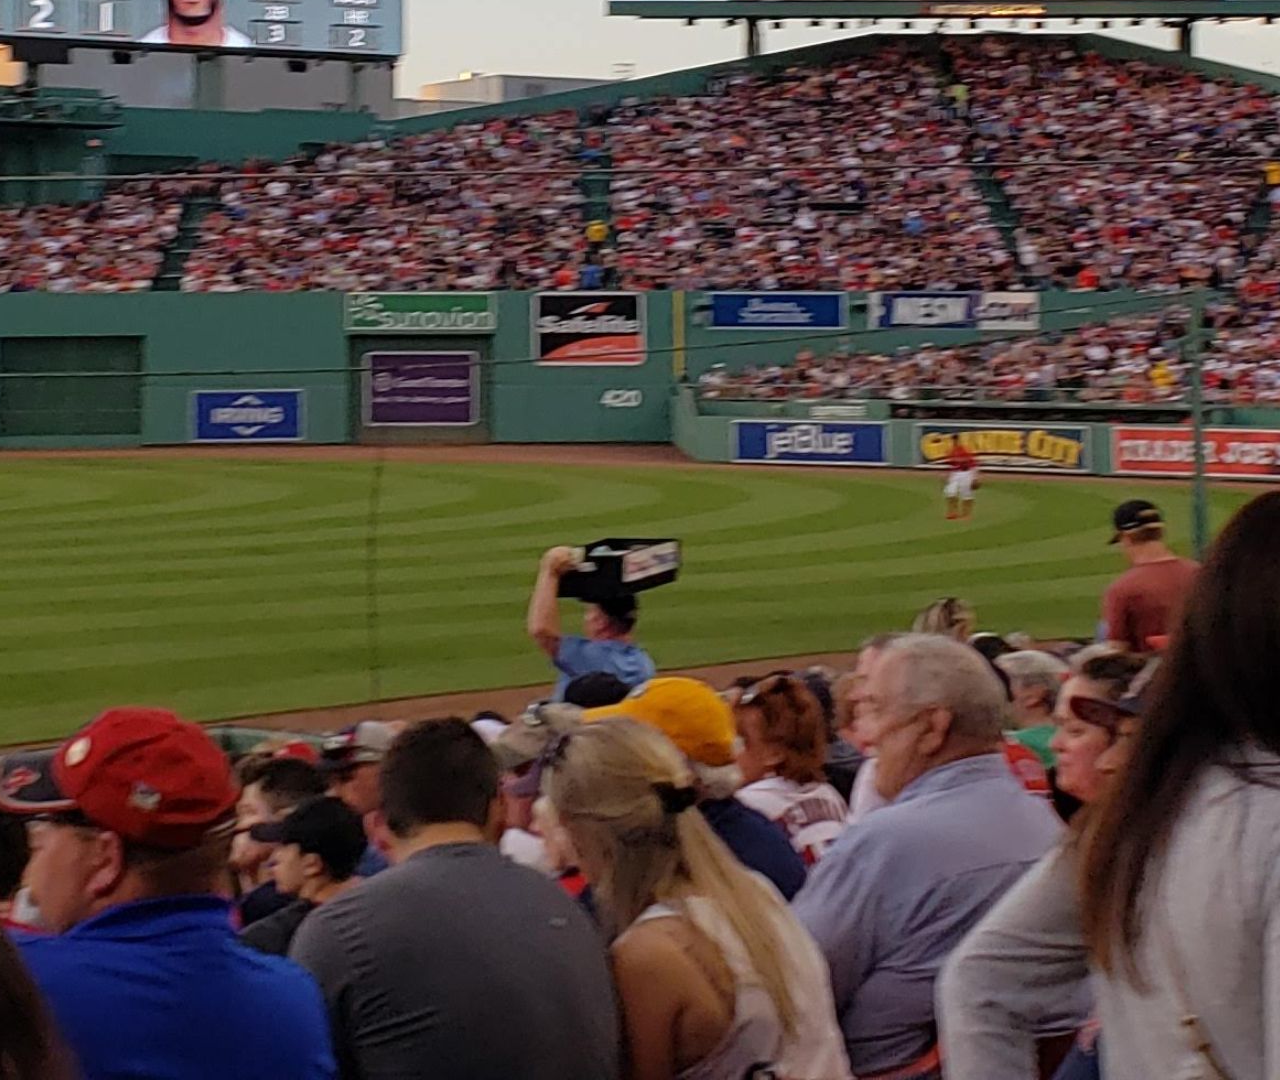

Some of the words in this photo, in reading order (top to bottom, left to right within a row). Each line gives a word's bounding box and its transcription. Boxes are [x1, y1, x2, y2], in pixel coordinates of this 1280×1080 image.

[29, 0, 55, 29] 2
[99, 1, 114, 33] 1
[267, 24, 285, 43] 3
[348, 29, 367, 47] 2
[600, 389, 642, 407] 420
[764, 424, 854, 458] jetBlue
